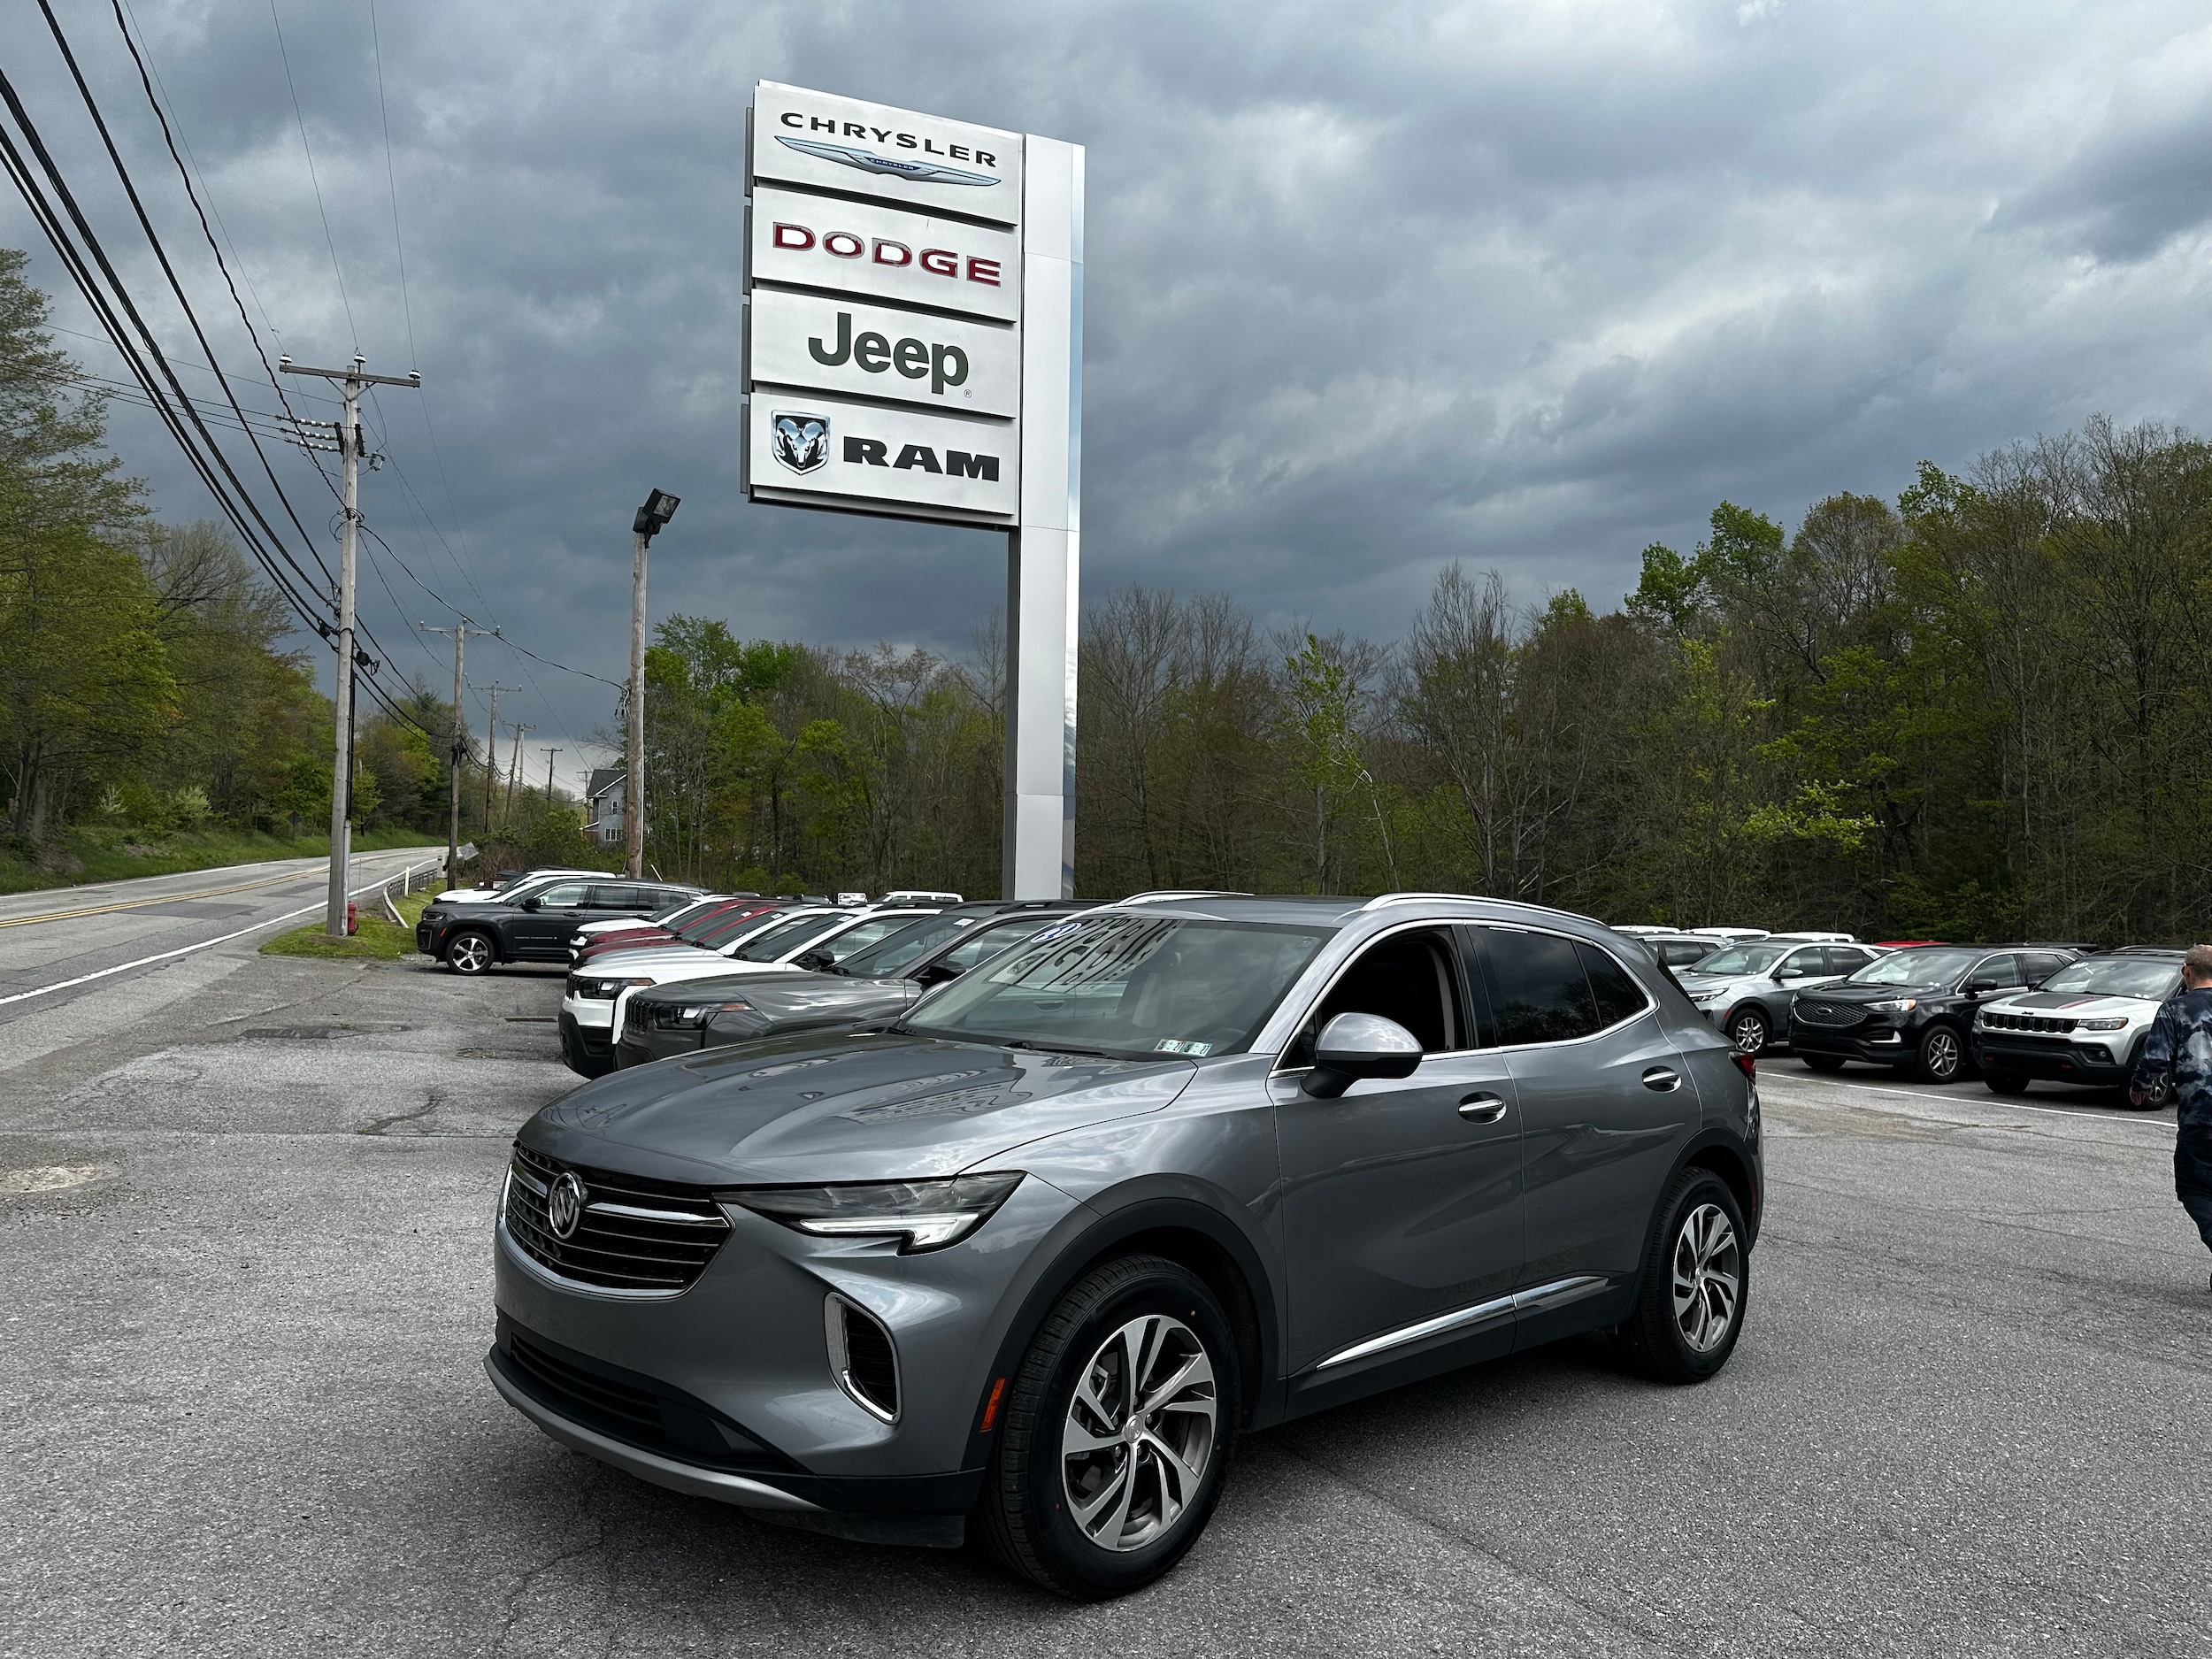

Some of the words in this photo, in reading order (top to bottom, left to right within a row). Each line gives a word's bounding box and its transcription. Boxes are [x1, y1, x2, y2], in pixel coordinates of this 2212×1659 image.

[780, 112, 996, 167] CHRYSLER
[772, 221, 1002, 288] DODGE
[808, 311, 970, 395] Jeep
[843, 435, 1000, 482] RAM
